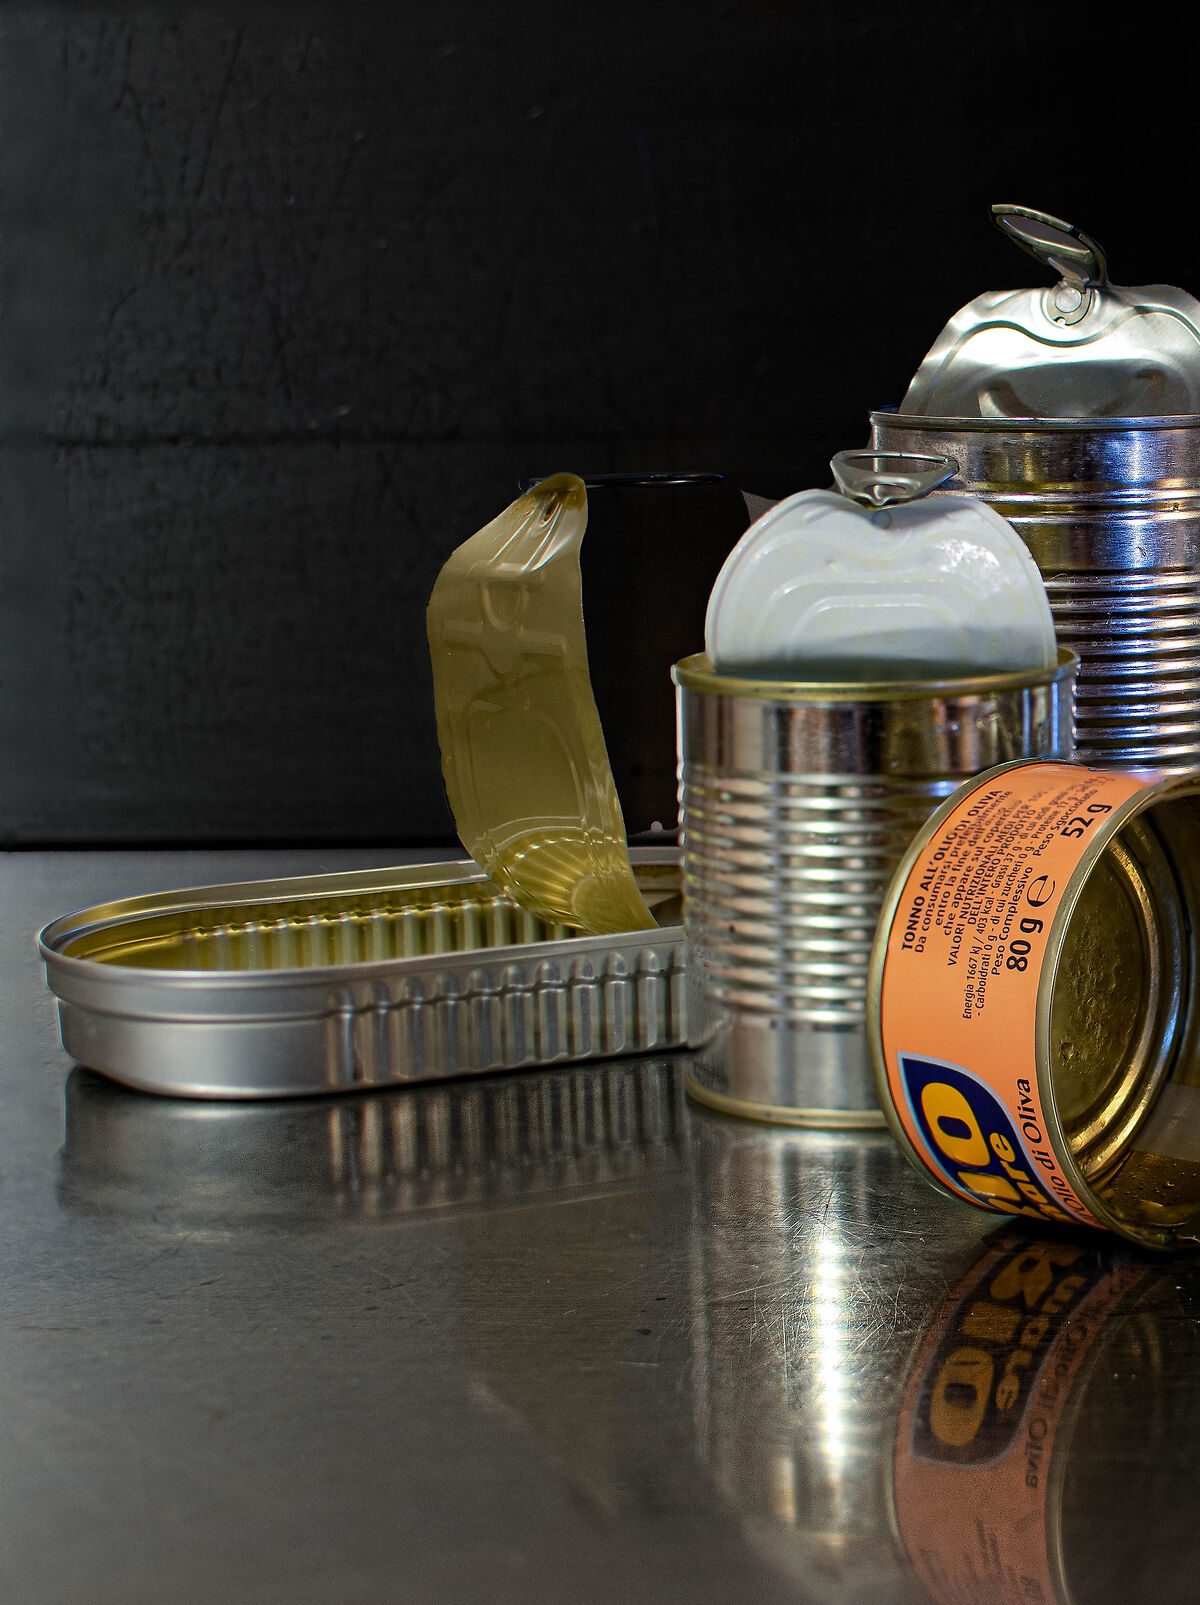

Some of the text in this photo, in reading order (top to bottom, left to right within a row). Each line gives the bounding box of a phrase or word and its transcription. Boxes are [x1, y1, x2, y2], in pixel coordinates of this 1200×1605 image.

[1059, 803, 1113, 839] 52 g
[1011, 844, 1023, 852] g
[1018, 830, 1029, 841] di
[1024, 844, 1036, 852] g
[1032, 833, 1055, 857] Peso
[902, 789, 1003, 951] TONNO ALL'OLIO DI OLIVA
[967, 808, 1037, 925] DELL'INTERO PRODOTTO
[1003, 852, 1016, 864] 37
[935, 890, 951, 927] entro
[944, 876, 957, 887] la
[951, 850, 972, 872] fine
[990, 863, 1009, 889] Grassi
[1001, 860, 1024, 897] zuccheri
[943, 912, 956, 936] che
[951, 865, 974, 909] appare
[971, 846, 985, 863] sul
[947, 921, 965, 966] VALORI
[958, 845, 999, 919] NUTRIZIONALI
[998, 820, 1017, 843] MEDI
[914, 936, 927, 953] Da
[922, 860, 953, 932] consumarsi
[980, 896, 995, 917] kcal
[995, 898, 1007, 913] cui
[976, 917, 988, 935] 403
[991, 914, 1001, 925] di
[991, 865, 1034, 976] Peso Complessivo
[972, 936, 985, 945] /
[987, 934, 998, 942] g
[1006, 939, 1032, 973] 80
[1019, 917, 1044, 934] g
[966, 958, 979, 981] 1667
[974, 953, 993, 1010] Carboidrati
[962, 983, 976, 1020] Energia
[1016, 1078, 1043, 1145] Oliva
[1032, 1149, 1056, 1172] di
